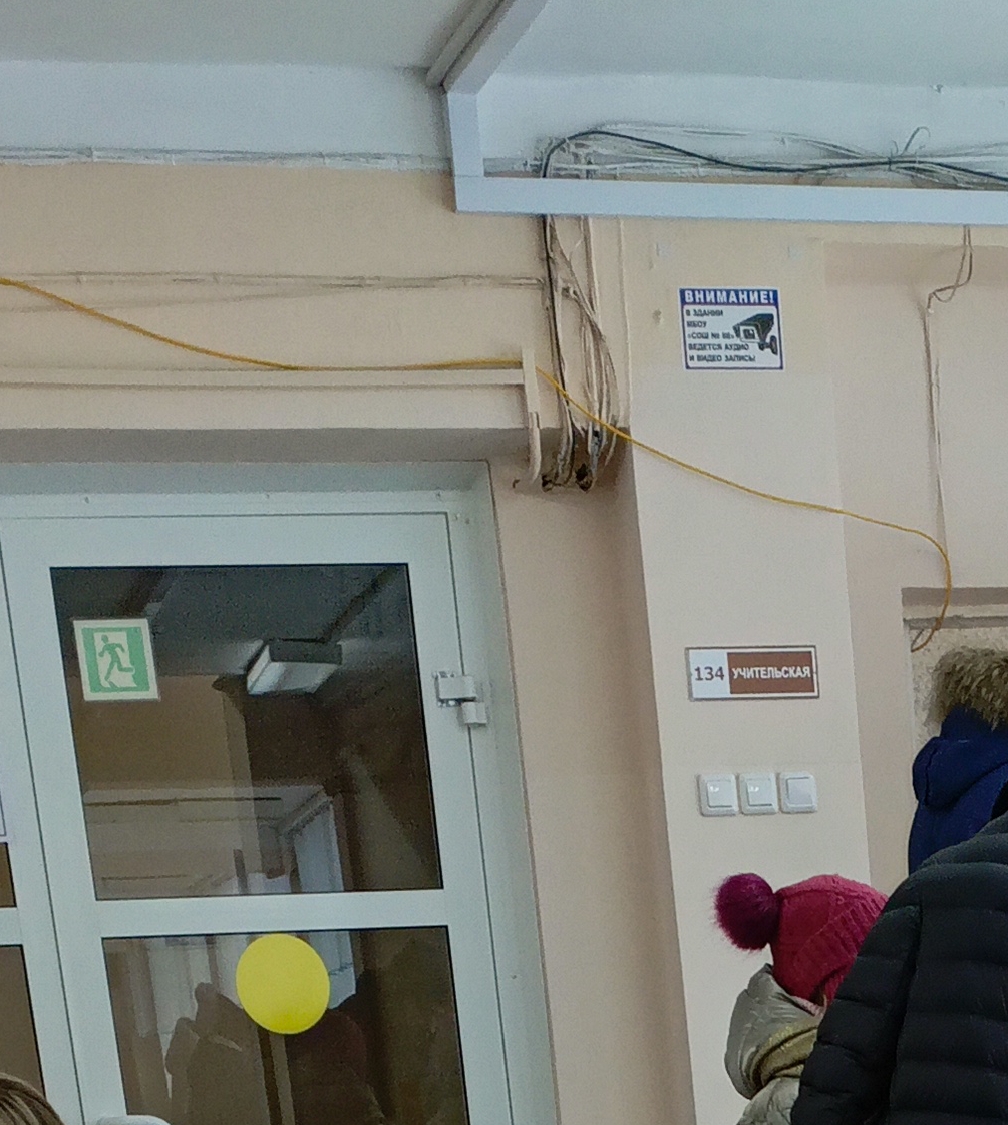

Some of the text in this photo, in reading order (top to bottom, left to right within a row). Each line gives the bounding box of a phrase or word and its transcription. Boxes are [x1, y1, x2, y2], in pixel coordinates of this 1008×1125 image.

[684, 290, 774, 303] ВНИМАНИЕ!
[724, 343, 749, 351] АУДИО
[689, 354, 695, 362] И
[694, 666, 811, 681] 134 УЧИТЕЛЬСКАЯ
